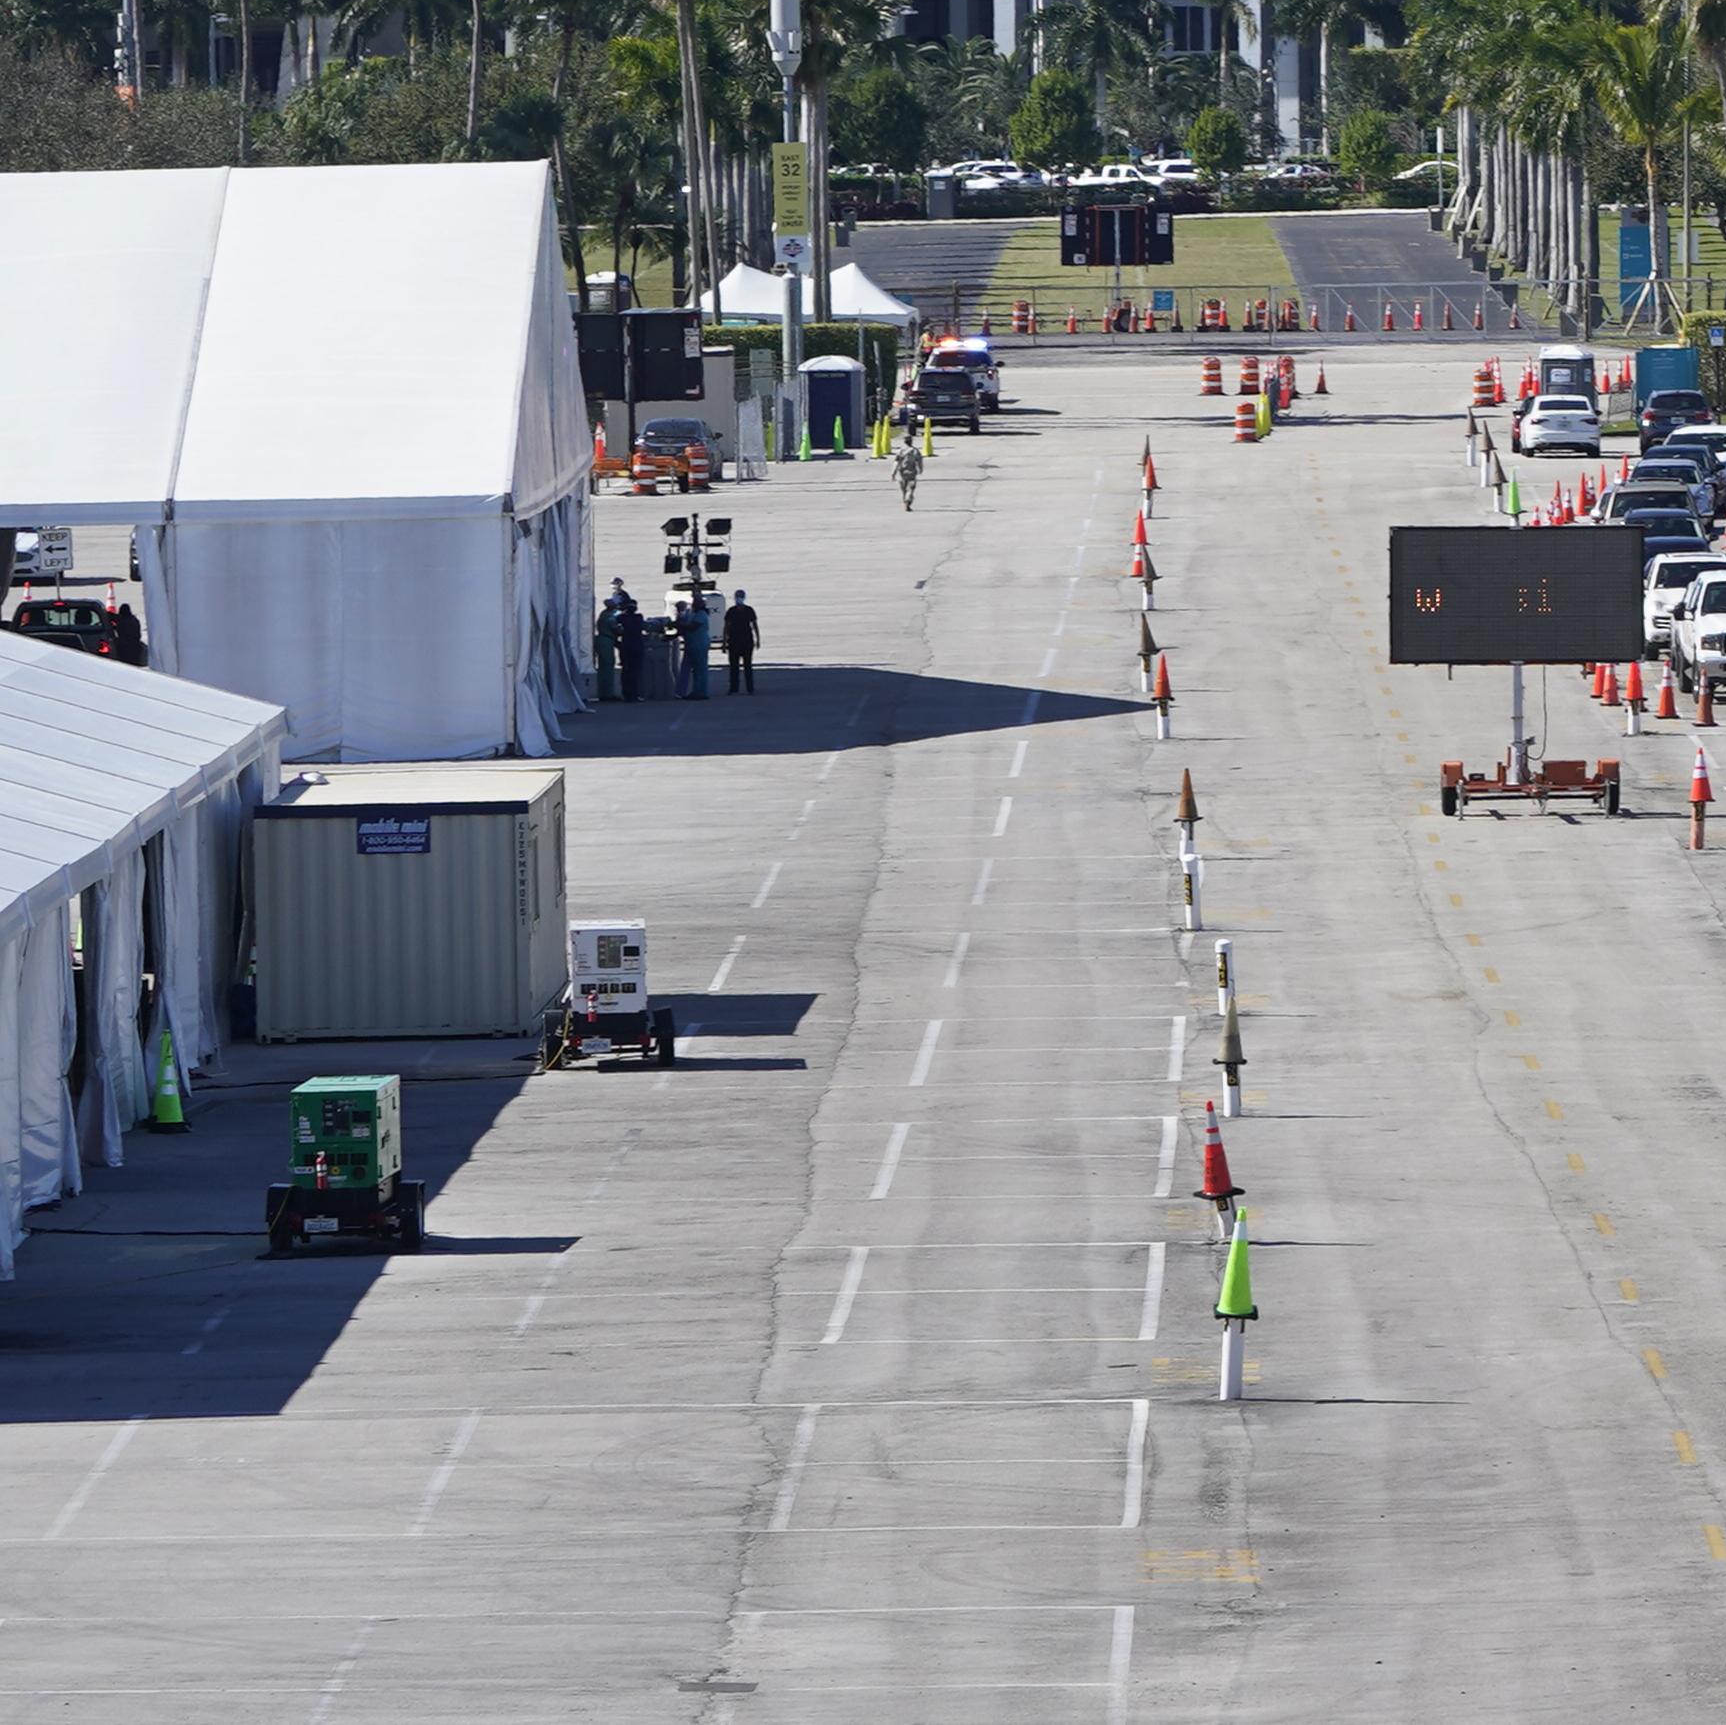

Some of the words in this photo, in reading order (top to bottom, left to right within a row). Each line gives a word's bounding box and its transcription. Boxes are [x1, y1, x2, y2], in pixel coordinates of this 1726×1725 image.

[781, 163, 801, 177] 32
[42, 532, 68, 542] KEEP
[43, 557, 69, 568] LEFT
[358, 817, 400, 834] mobile
[400, 819, 429, 834] mini
